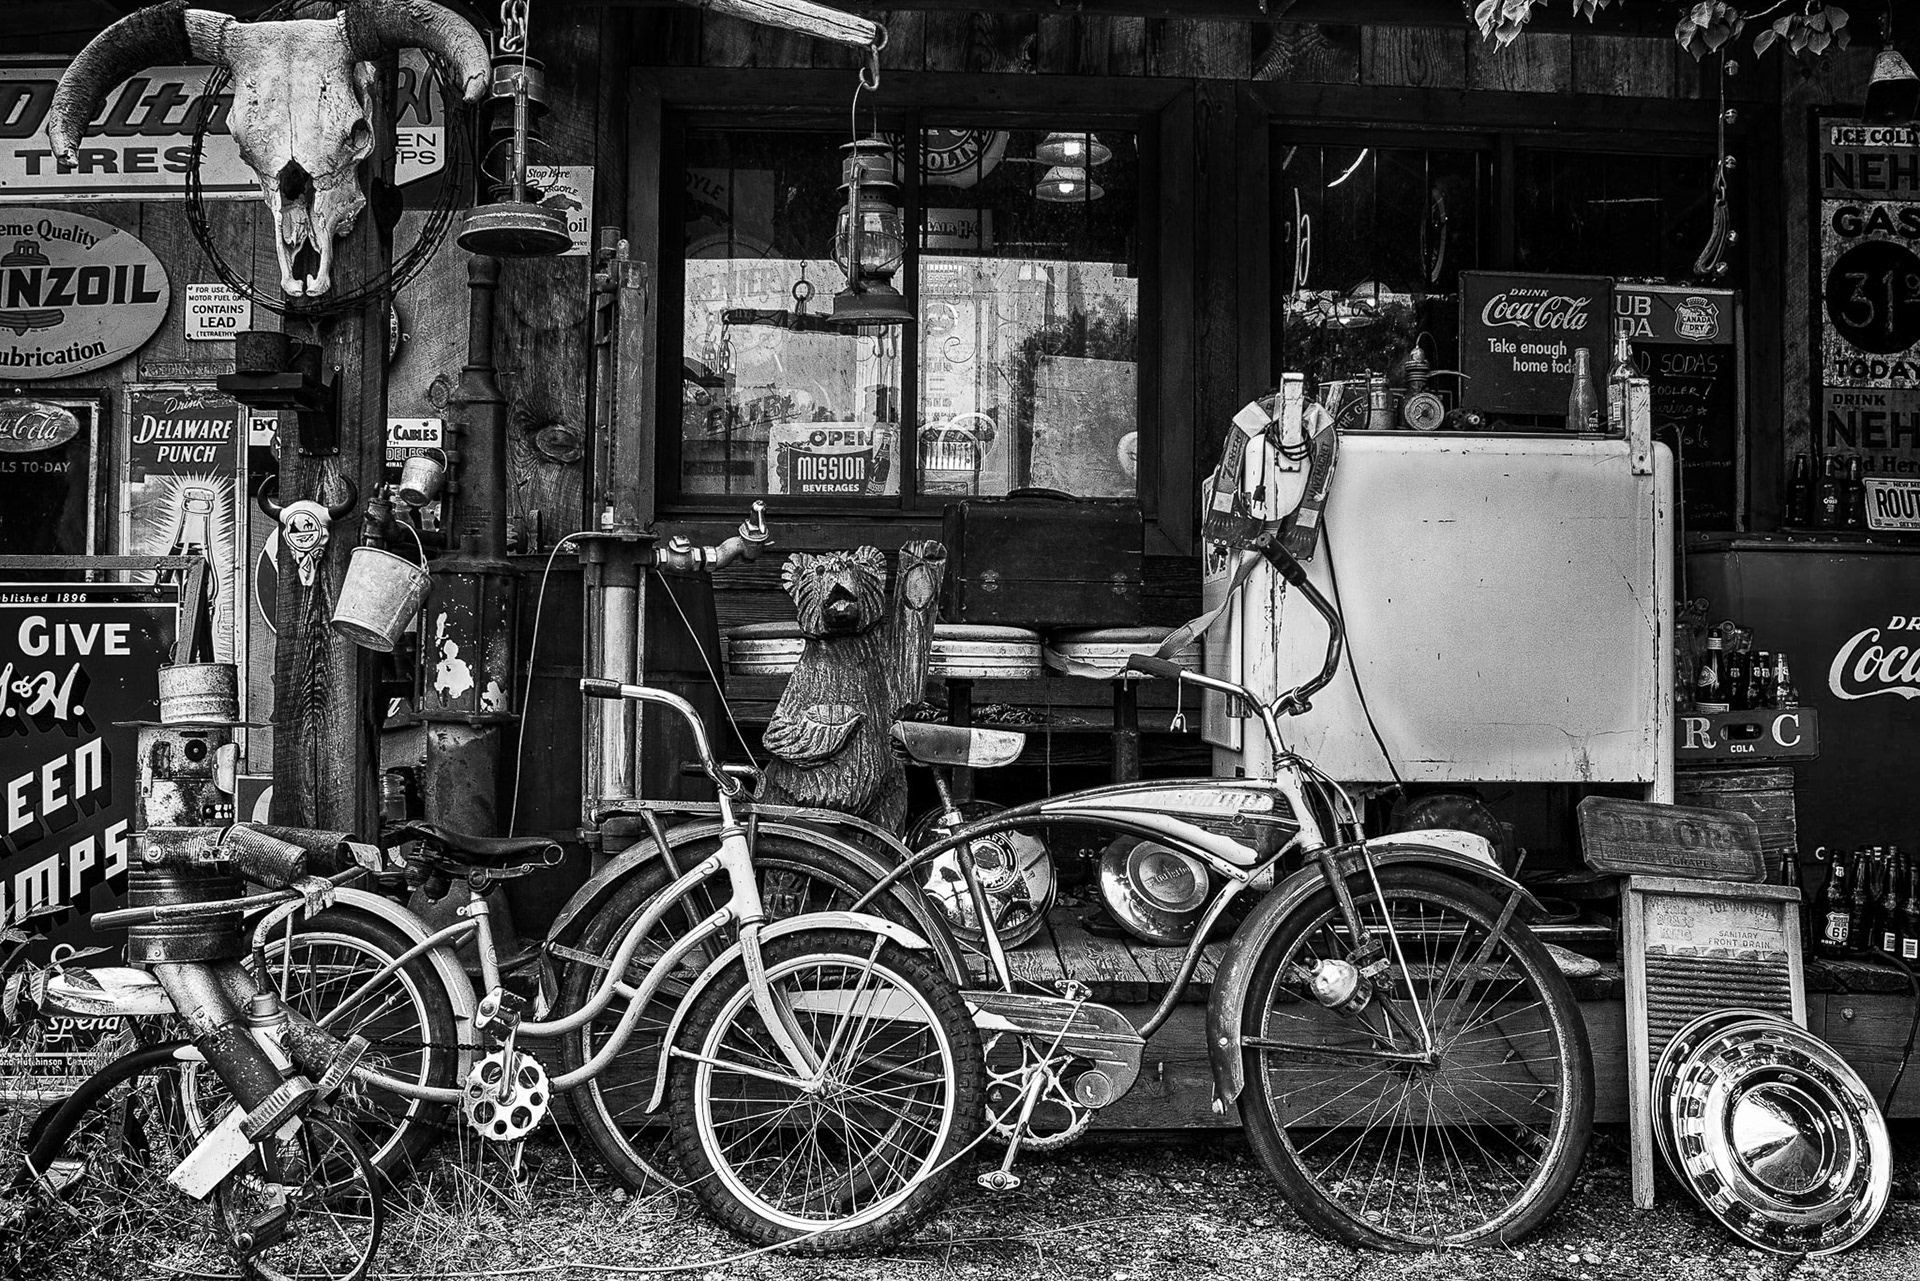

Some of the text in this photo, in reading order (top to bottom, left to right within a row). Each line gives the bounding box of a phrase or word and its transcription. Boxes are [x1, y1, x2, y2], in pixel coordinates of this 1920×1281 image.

[0, 78, 235, 138] Dlta
[1870, 128, 1918, 145] COLD
[401, 151, 436, 164] PS
[526, 169, 547, 180] Stop
[1831, 206, 1920, 240] GAS
[37, 219, 100, 250] Quality
[0, 264, 161, 307] NZOIL
[195, 286, 211, 294] FOR
[212, 286, 224, 294] USE
[1509, 288, 1550, 297] DRINK
[192, 305, 244, 314] CONTAINS
[1481, 293, 1593, 330] Coca-Cola
[200, 317, 236, 328] LEAD
[1614, 317, 1654, 337] DA
[1682, 315, 1711, 323] CANADA
[1488, 338, 1567, 359] Take enough
[1513, 356, 1549, 372] home
[164, 397, 204, 415] Drink
[1833, 393, 1886, 405] DRINK
[133, 415, 233, 444] DELAWARE
[394, 424, 438, 441] CABLES
[810, 430, 874, 447] OPEN
[157, 445, 217, 462] PUNCH
[22, 461, 71, 473] TO-DAY
[797, 456, 865, 480] MISSION
[802, 484, 860, 492] BEVERAGES
[57, 593, 87, 603] 1896
[18, 615, 131, 657] GIVE
[1680, 713, 1801, 749] R C
[1730, 744, 1755, 753] COLA
[0, 818, 128, 926] MPS
[1718, 930, 1758, 940] SANITARY
[1832, 927, 1848, 938] 66
[1708, 937, 1770, 949] FRONT DRAIN
